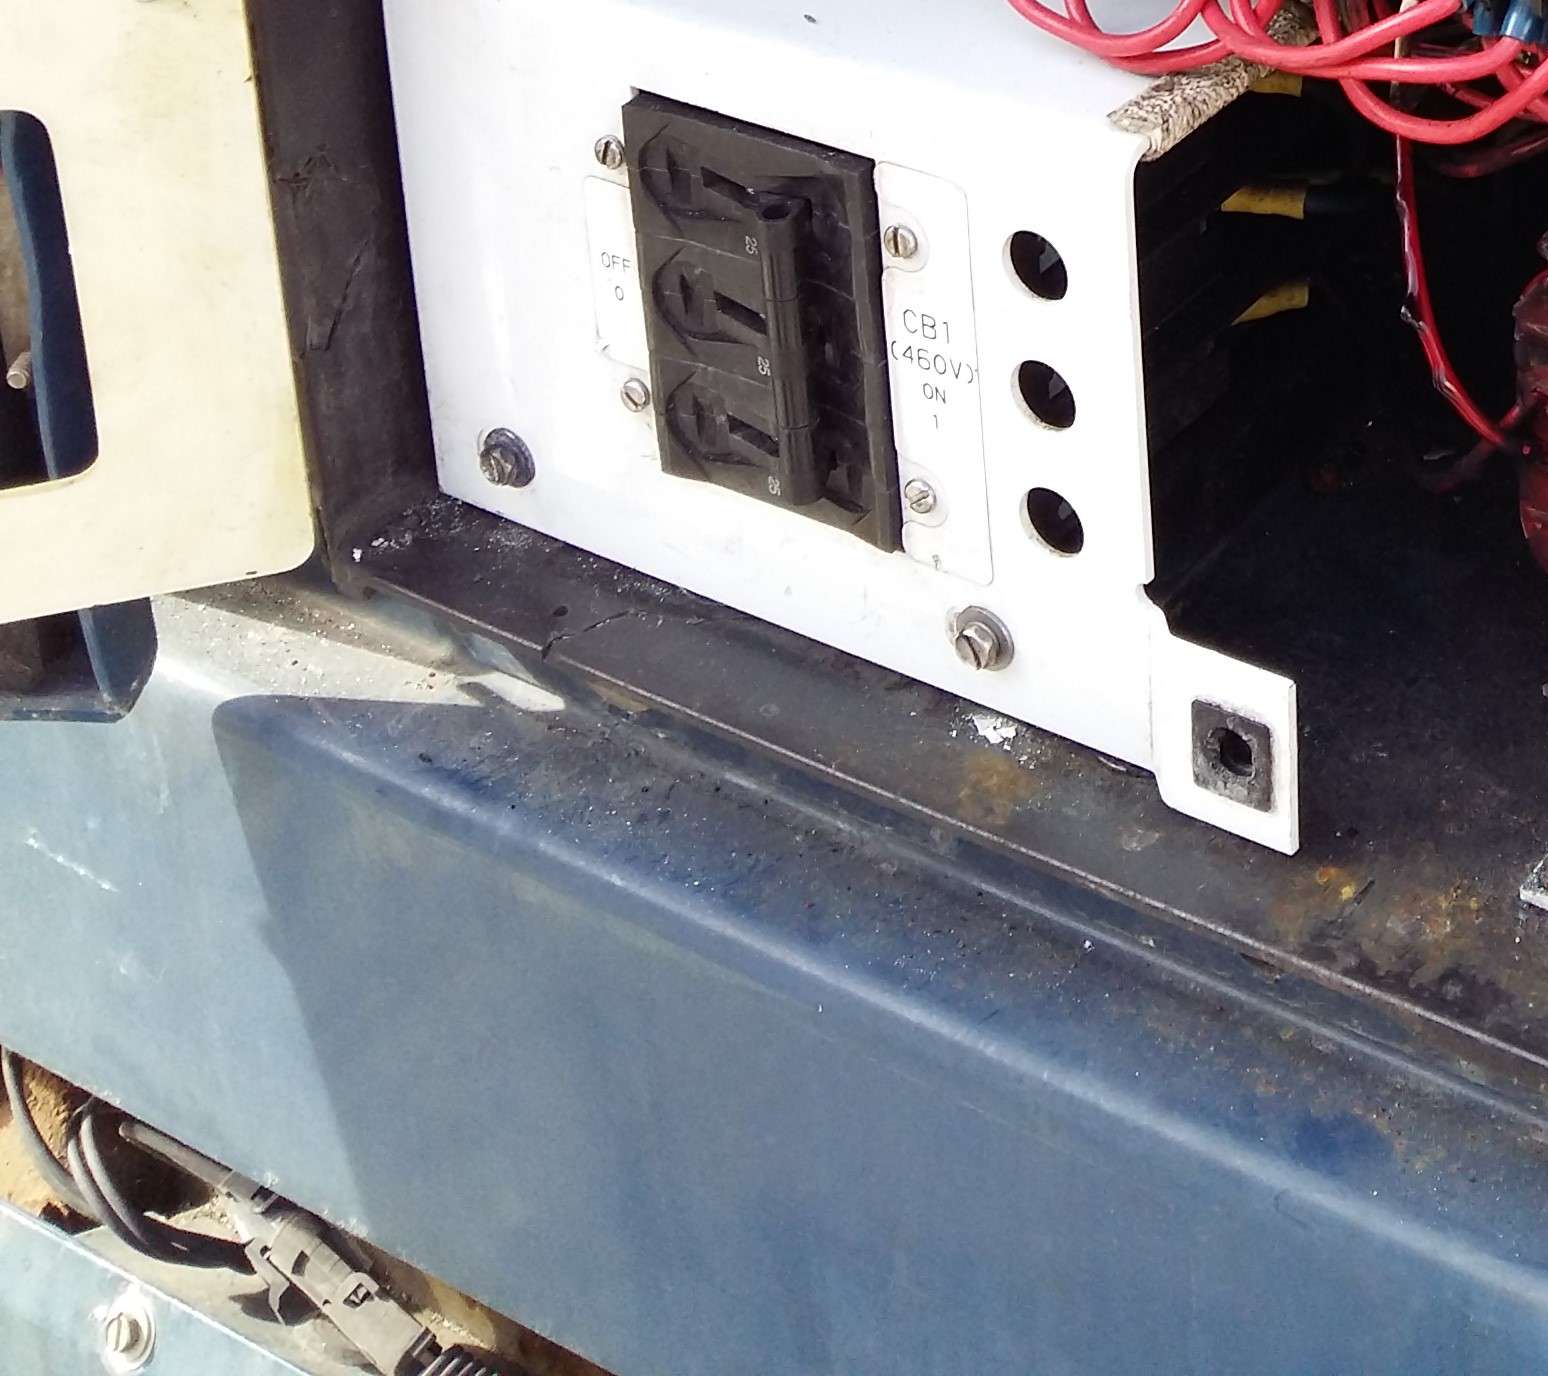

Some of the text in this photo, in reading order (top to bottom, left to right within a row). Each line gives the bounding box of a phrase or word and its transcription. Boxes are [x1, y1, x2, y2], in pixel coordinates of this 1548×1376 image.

[744, 235, 757, 255] 25
[600, 251, 631, 272] OFF
[902, 308, 952, 344] CB1
[756, 355, 770, 376] 25
[890, 339, 975, 385] (460V)
[922, 383, 947, 405] ON
[768, 475, 781, 497] 25
